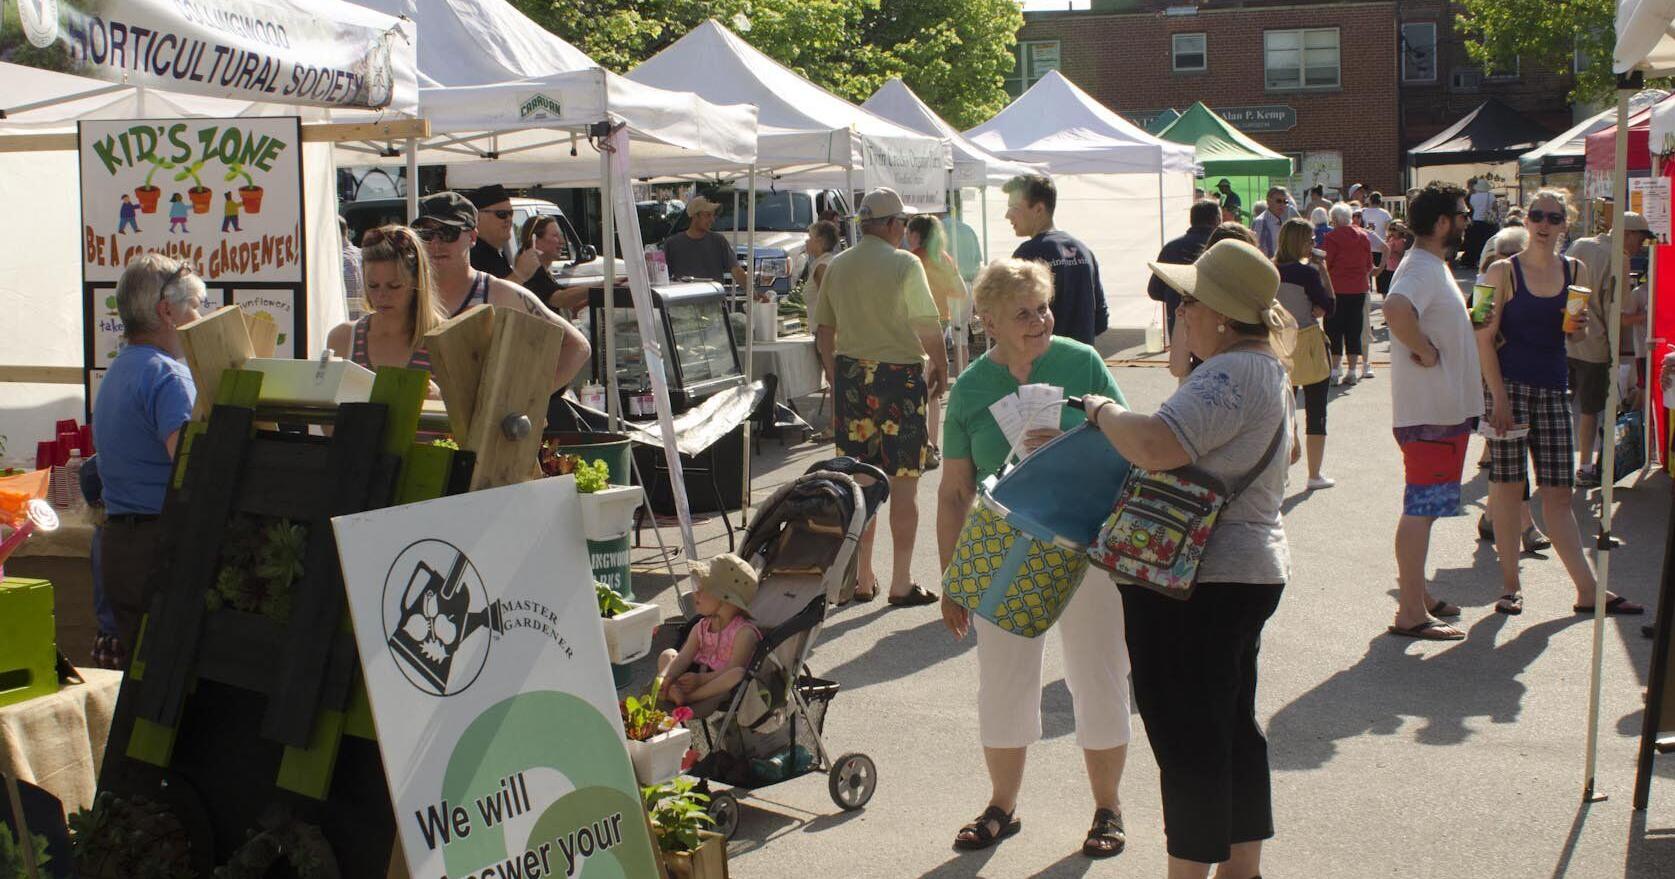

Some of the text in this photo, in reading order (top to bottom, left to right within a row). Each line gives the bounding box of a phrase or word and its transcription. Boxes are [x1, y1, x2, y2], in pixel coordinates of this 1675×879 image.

[67, 13, 364, 102] HORTICULTURAL SOCIETY
[1256, 109, 1286, 121] Kemp
[93, 123, 287, 176] KID'S ZONE
[86, 225, 105, 266] BE
[110, 233, 120, 267] A
[209, 223, 300, 279] GARDENER!
[501, 600, 557, 625] MASTER
[504, 618, 573, 660] GARDENER
[415, 773, 531, 851] We will
[558, 813, 621, 877] your
